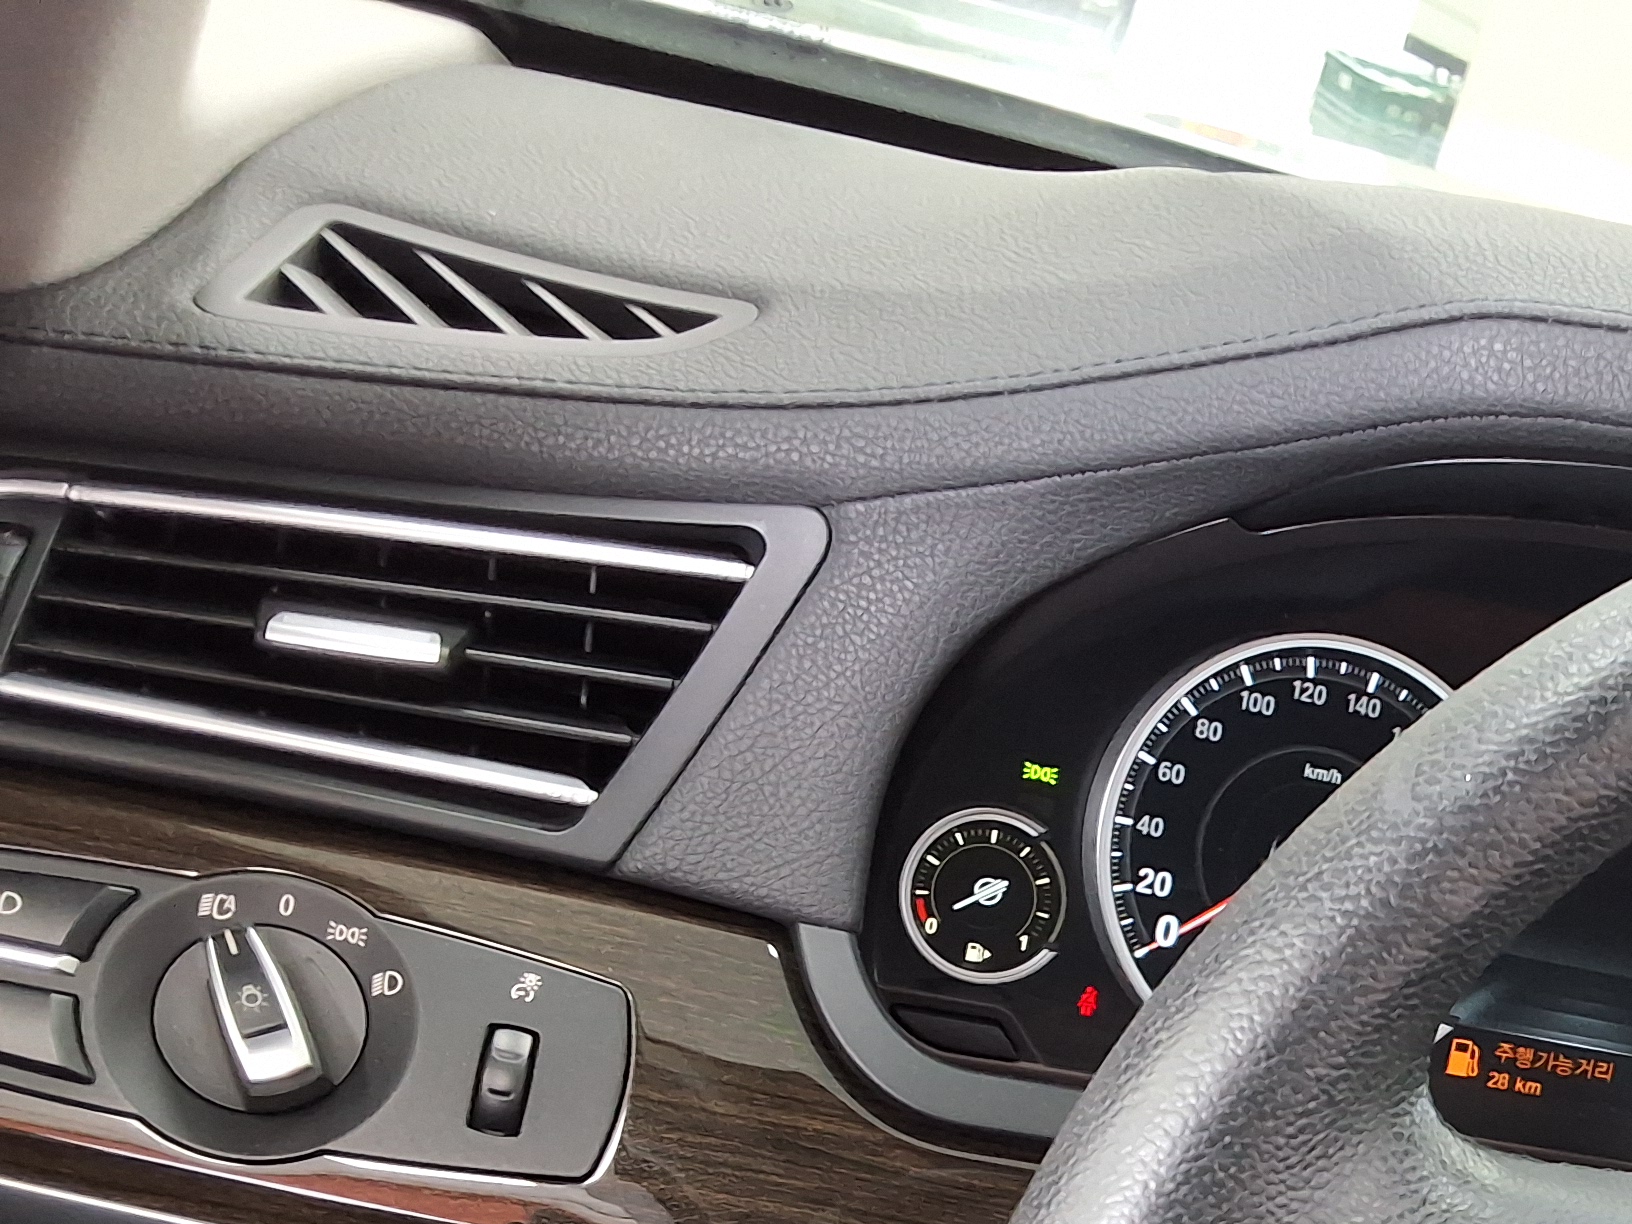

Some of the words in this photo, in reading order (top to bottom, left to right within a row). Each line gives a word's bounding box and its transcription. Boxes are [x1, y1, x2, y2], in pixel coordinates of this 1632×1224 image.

[1240, 690, 1275, 716] 100
[1293, 680, 1327, 705] 120
[1347, 693, 1381, 718] 140
[1195, 718, 1222, 742] 80
[1158, 762, 1185, 785] 60
[1303, 763, 1342, 785] km/h
[1136, 815, 1164, 838] 40
[1136, 867, 1172, 898] 20
[278, 894, 296, 917] 0
[925, 917, 938, 935] 0
[1155, 914, 1178, 947] 0
[1020, 935, 1029, 952] 1
[1494, 1042, 1615, 1083] 주행가능거리
[1486, 1071, 1510, 1091] 28
[1514, 1077, 1542, 1096] km
